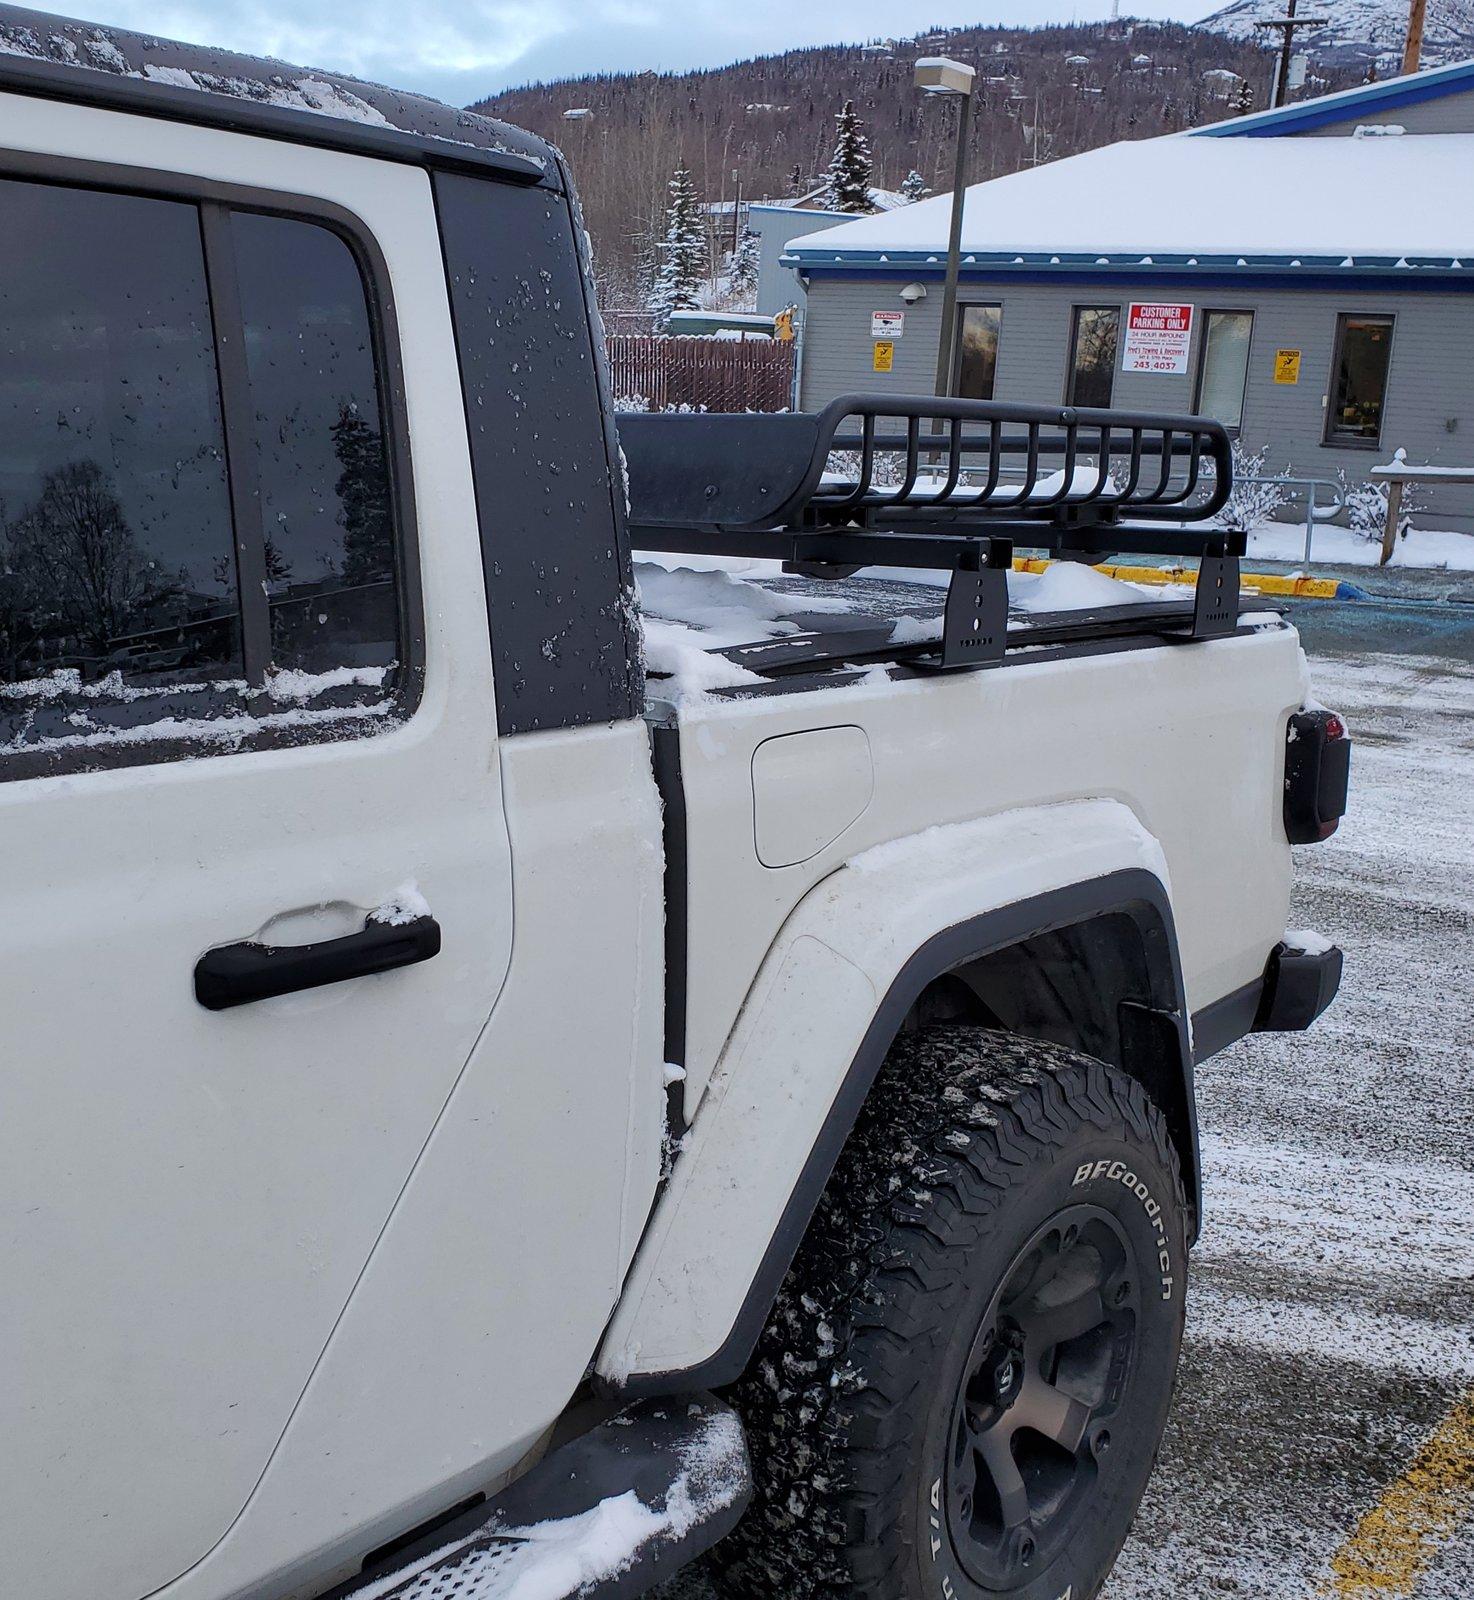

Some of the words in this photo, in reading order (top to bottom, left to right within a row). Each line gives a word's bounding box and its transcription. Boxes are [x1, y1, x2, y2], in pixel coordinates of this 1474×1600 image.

[1140, 307, 1181, 318] CUSTOMER
[1132, 317, 1165, 329] PARKING
[1166, 319, 1187, 330] ONLY
[1072, 1160, 1173, 1300] BFGoodrich
